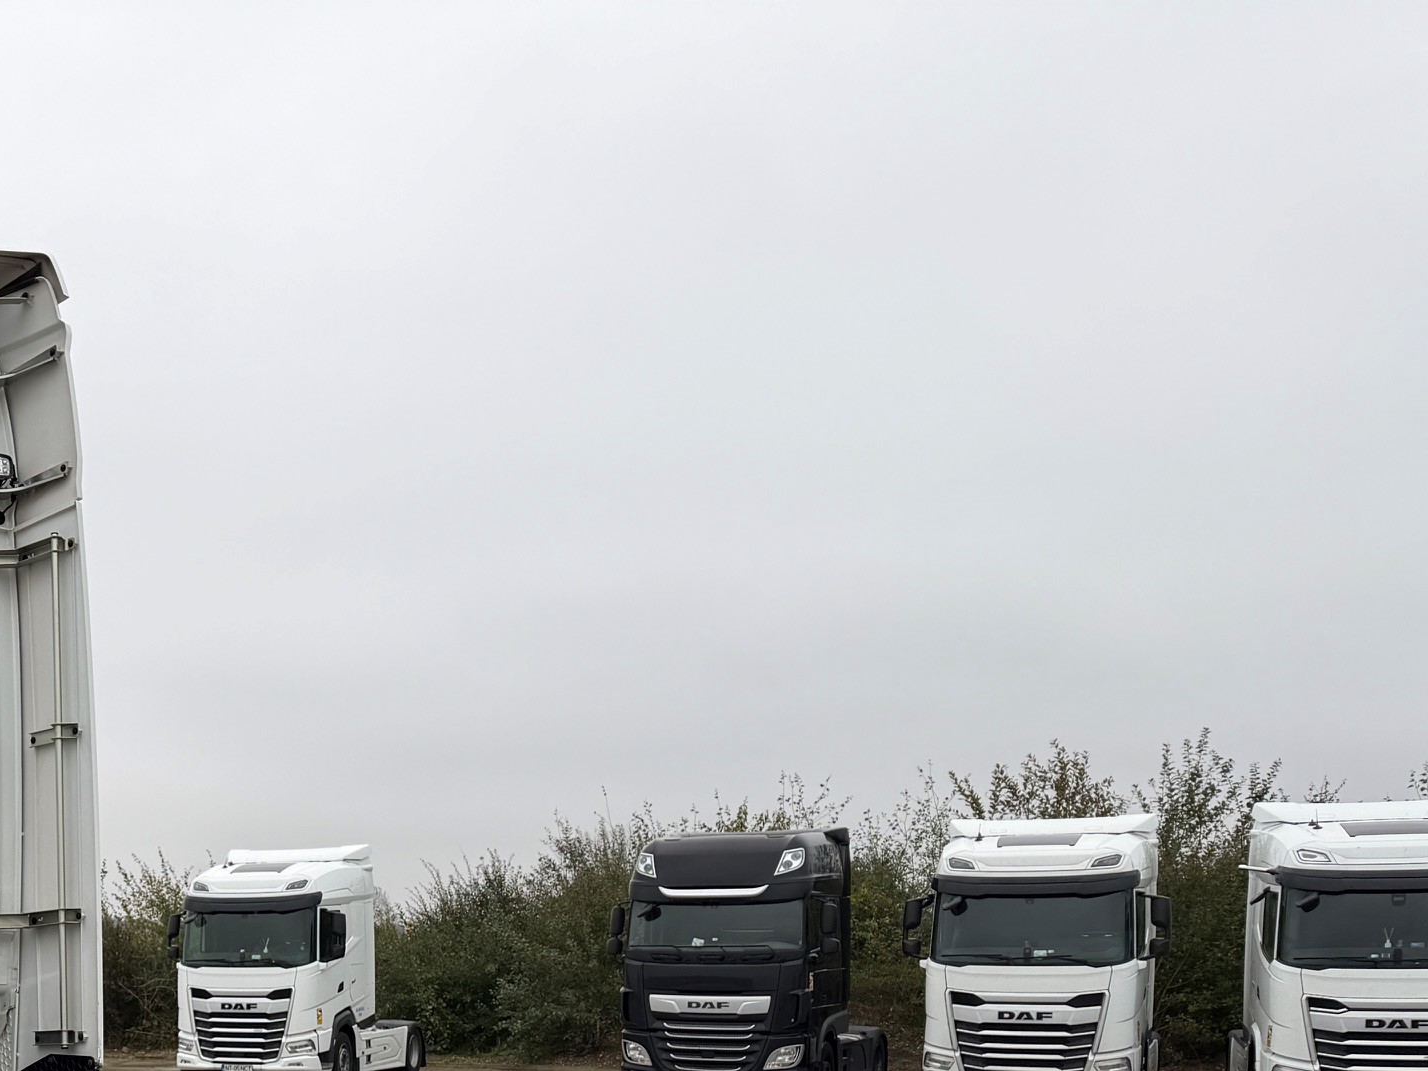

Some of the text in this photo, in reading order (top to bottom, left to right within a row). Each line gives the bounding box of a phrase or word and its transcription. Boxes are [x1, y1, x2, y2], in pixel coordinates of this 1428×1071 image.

[687, 1001, 729, 1009] DAF
[998, 1011, 1053, 1020] DAF
[1365, 1019, 1428, 1029] DAF
